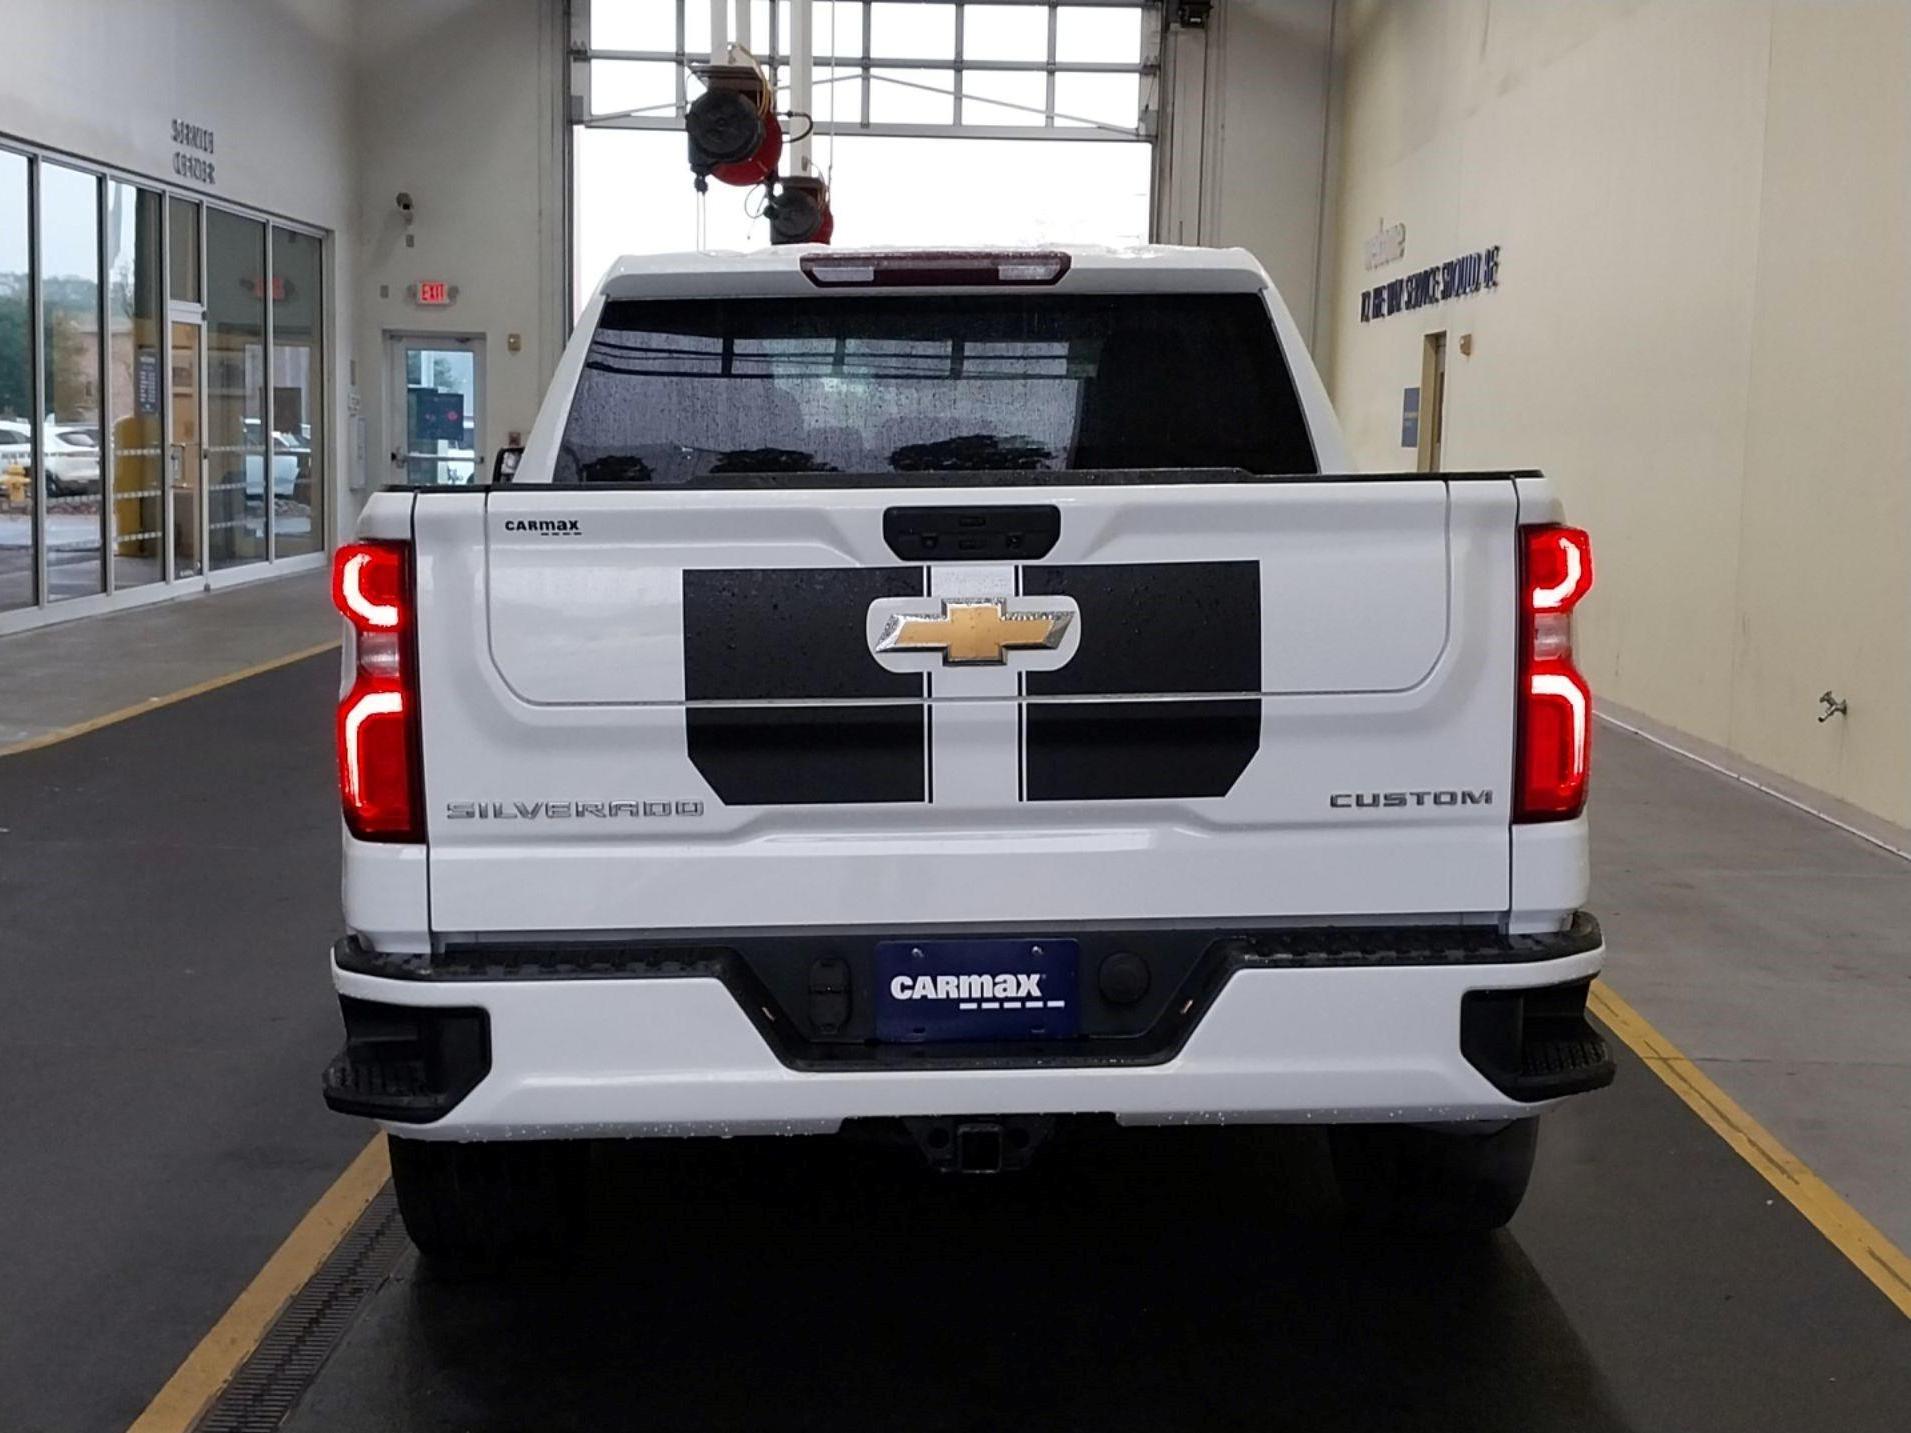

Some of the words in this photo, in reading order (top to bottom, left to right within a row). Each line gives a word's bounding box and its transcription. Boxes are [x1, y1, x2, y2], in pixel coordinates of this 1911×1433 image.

[421, 281, 445, 302] EXIT
[1330, 790, 1493, 808] CUSTOM
[446, 800, 705, 819] SILVERADO
